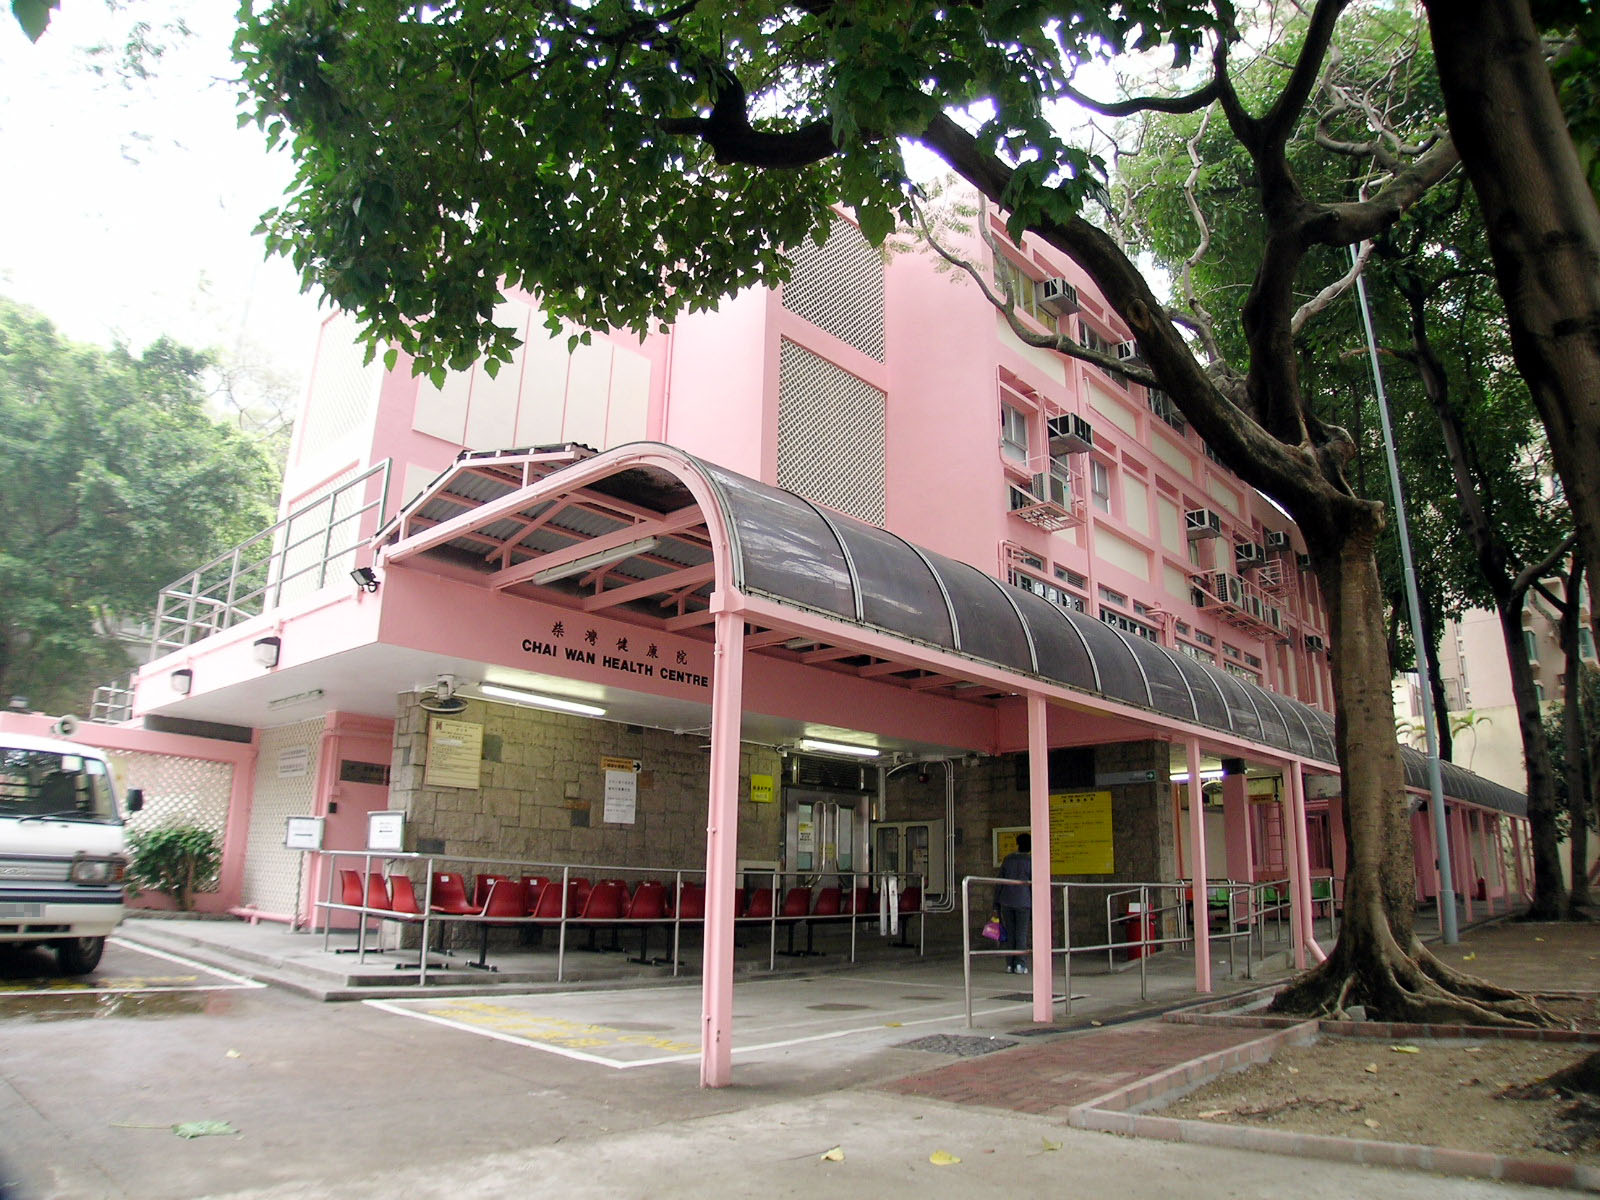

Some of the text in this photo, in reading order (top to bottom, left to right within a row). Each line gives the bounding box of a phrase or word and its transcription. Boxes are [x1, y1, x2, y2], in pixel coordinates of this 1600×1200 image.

[522, 639, 709, 687] CHAI WAN HEALTH CENTRE
[551, 620, 688, 666] 柴灣健康院
